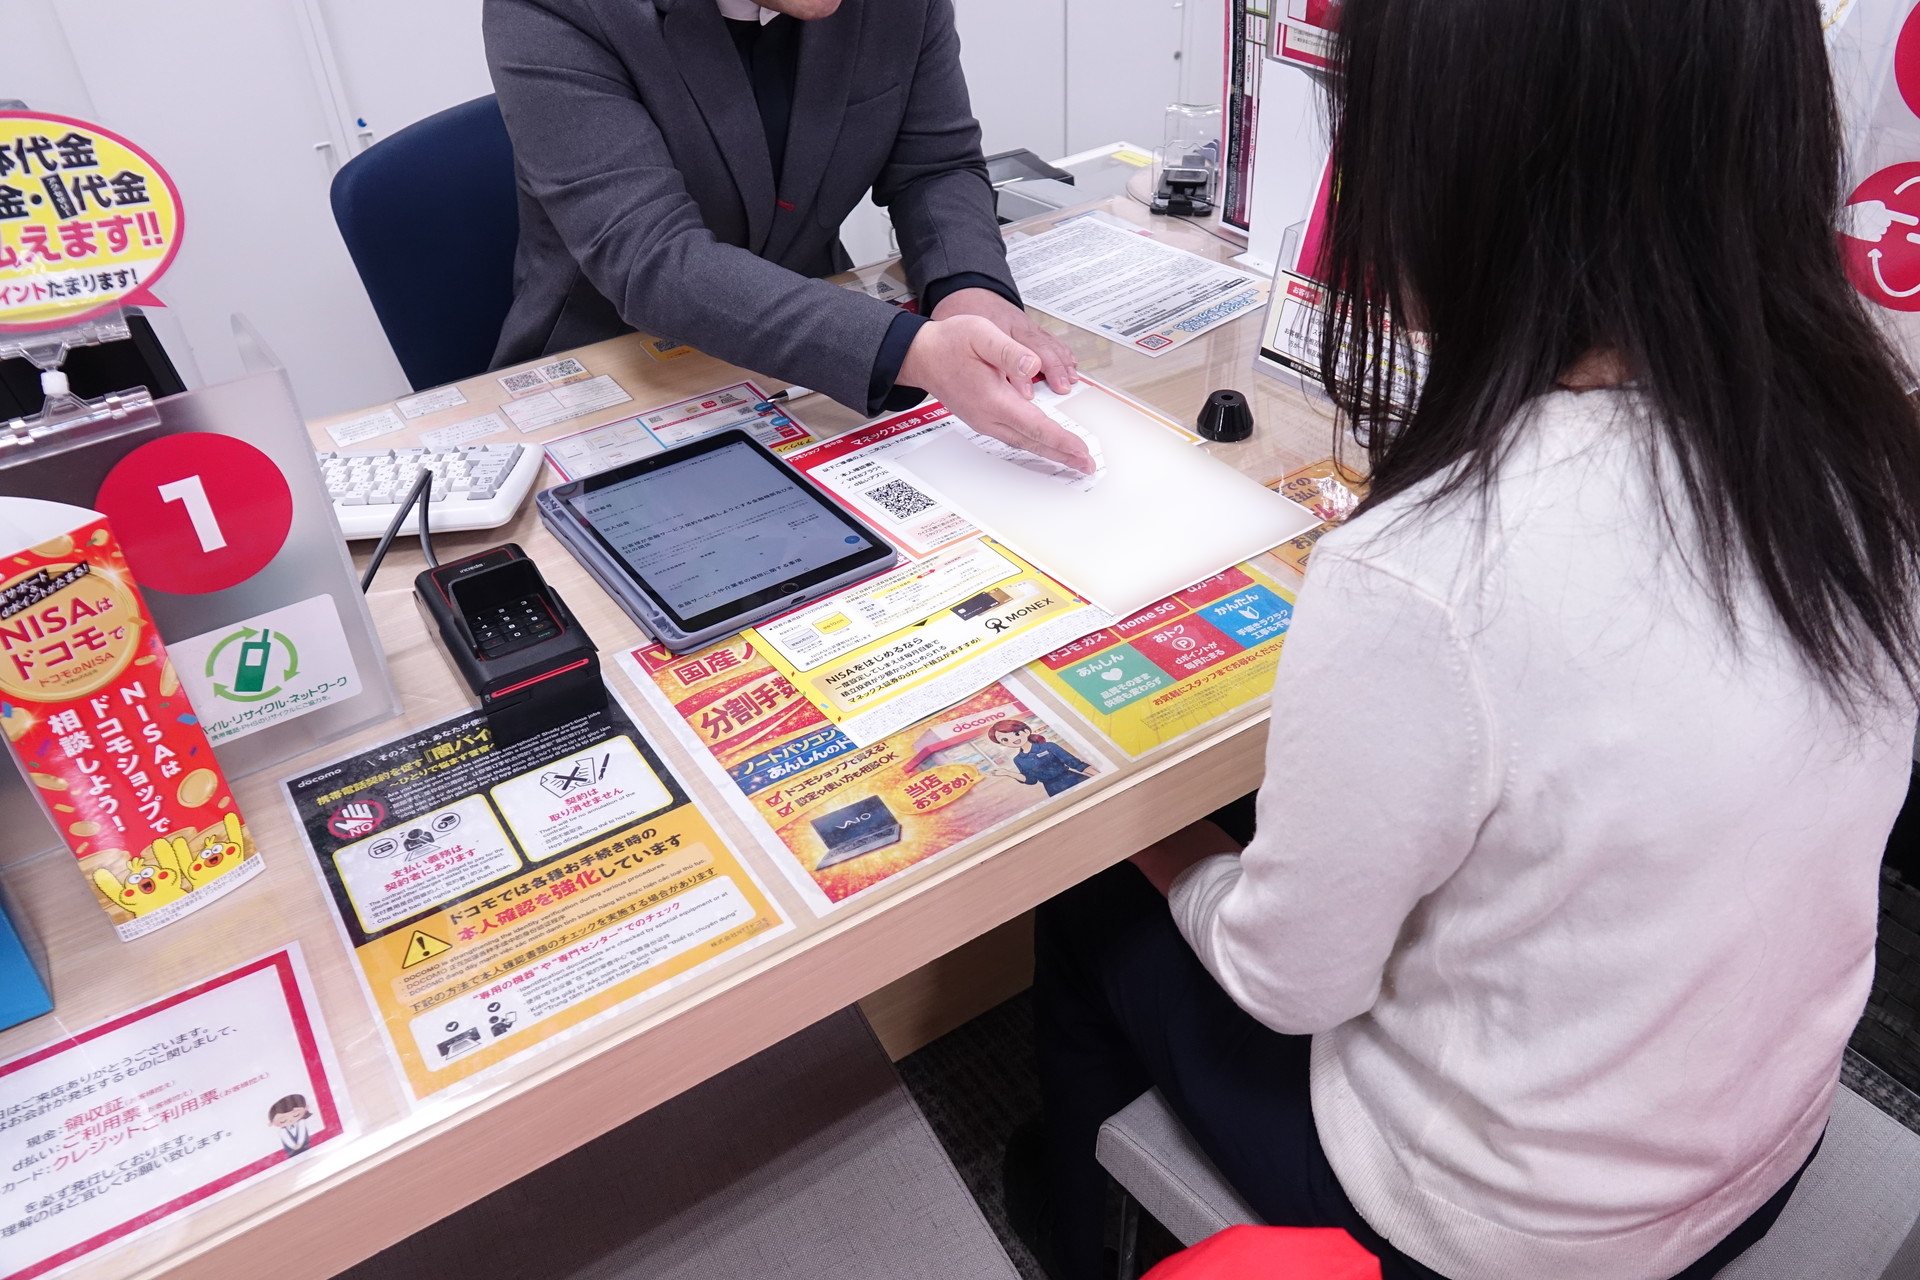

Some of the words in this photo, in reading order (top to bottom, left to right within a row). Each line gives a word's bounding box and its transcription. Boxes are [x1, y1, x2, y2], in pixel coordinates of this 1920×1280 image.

[70, 170, 150, 211] 代金
[849, 416, 922, 447] マネックス証券
[157, 474, 228, 554] 1
[0, 597, 113, 650] NISAは
[1004, 596, 1054, 622] MONEX
[1116, 610, 1156, 632] home
[1157, 602, 1177, 618] 5G
[1213, 593, 1260, 616] かんたん
[10, 625, 125, 681] ドコモで
[1049, 641, 1082, 663] ドコモ
[1083, 633, 1108, 650] ガス
[1151, 622, 1186, 645] おトク
[1174, 641, 1218, 666] dポイントが
[38, 651, 115, 688] ドコモのNISA
[824, 636, 924, 685] NISAをはじめるなら
[840, 644, 947, 698] 積立投資が少額からはじめられる
[1075, 653, 1125, 678] あんしん
[1183, 648, 1226, 671] 毎月たまる
[700, 675, 799, 740] 分割手数
[952, 711, 1006, 733] docomo
[119, 681, 183, 779] NISAは
[377, 716, 487, 762] そのスマホ、あなたが使
[743, 726, 842, 776] ノートパソコン
[48, 708, 127, 832] 相談しよう!
[90, 694, 172, 833] ドコモショップで
[297, 767, 342, 788] docomo
[315, 757, 425, 806] 携帯電話契約を促す
[785, 742, 890, 797] ドコモショップで買える!
[795, 750, 899, 808] 設定や使い方も相談OK
[548, 785, 625, 822] 取り消せません
[564, 787, 599, 806] 契約は
[904, 773, 943, 799] 当店
[913, 772, 975, 810] おすすめ!
[350, 822, 373, 838] NO
[836, 811, 872, 831] VAIO
[383, 847, 478, 892] 契約者にあります
[390, 843, 463, 879] 支払い義務は
[448, 826, 659, 926] ドコモでは各種お手続き時の
[454, 831, 685, 944] 本人確認を強化しています
[403, 963, 440, 983] DOCOMO
[448, 936, 499, 962] strengthening
[499, 930, 512, 939] the
[512, 918, 540, 934] identity
[539, 901, 579, 921] verification
[578, 891, 601, 904] during
[601, 879, 627, 894] various
[627, 861, 667, 882] procedures.
[411, 867, 716, 1012] 下記の方法で本人確認書類のチェックを実施する場合があります
[24, 1129, 194, 1216] を必ず発行しております。
